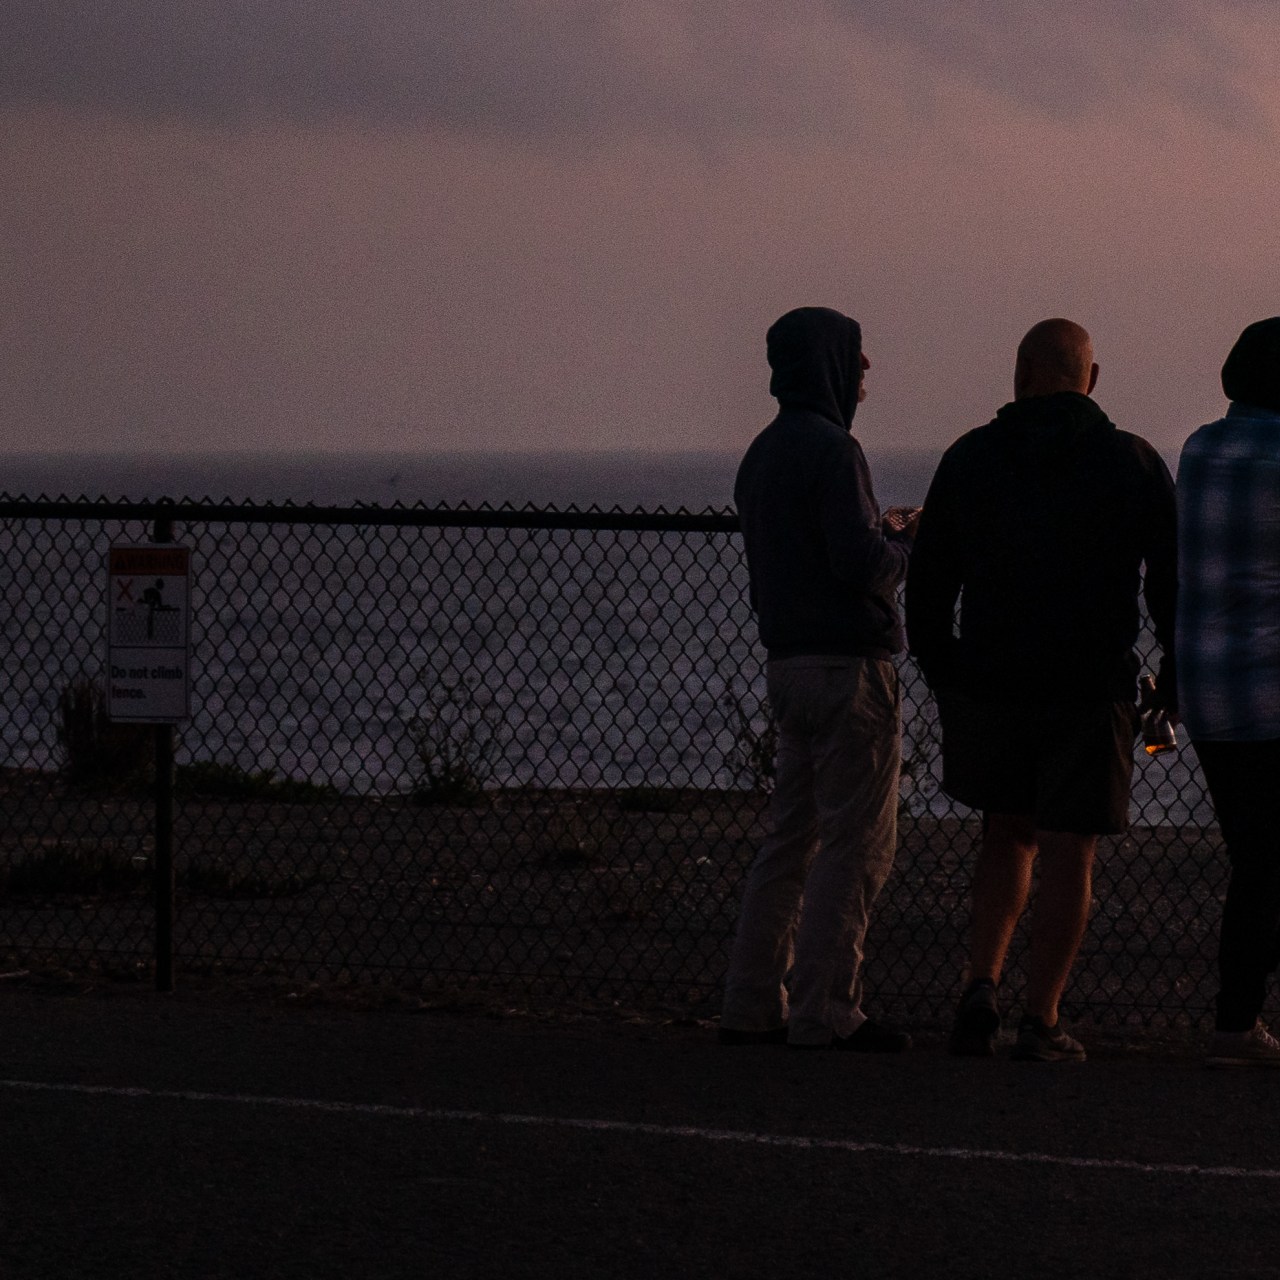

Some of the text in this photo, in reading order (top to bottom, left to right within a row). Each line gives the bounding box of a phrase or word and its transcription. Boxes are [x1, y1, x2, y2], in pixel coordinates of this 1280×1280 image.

[112, 665, 183, 679] Do not climb
